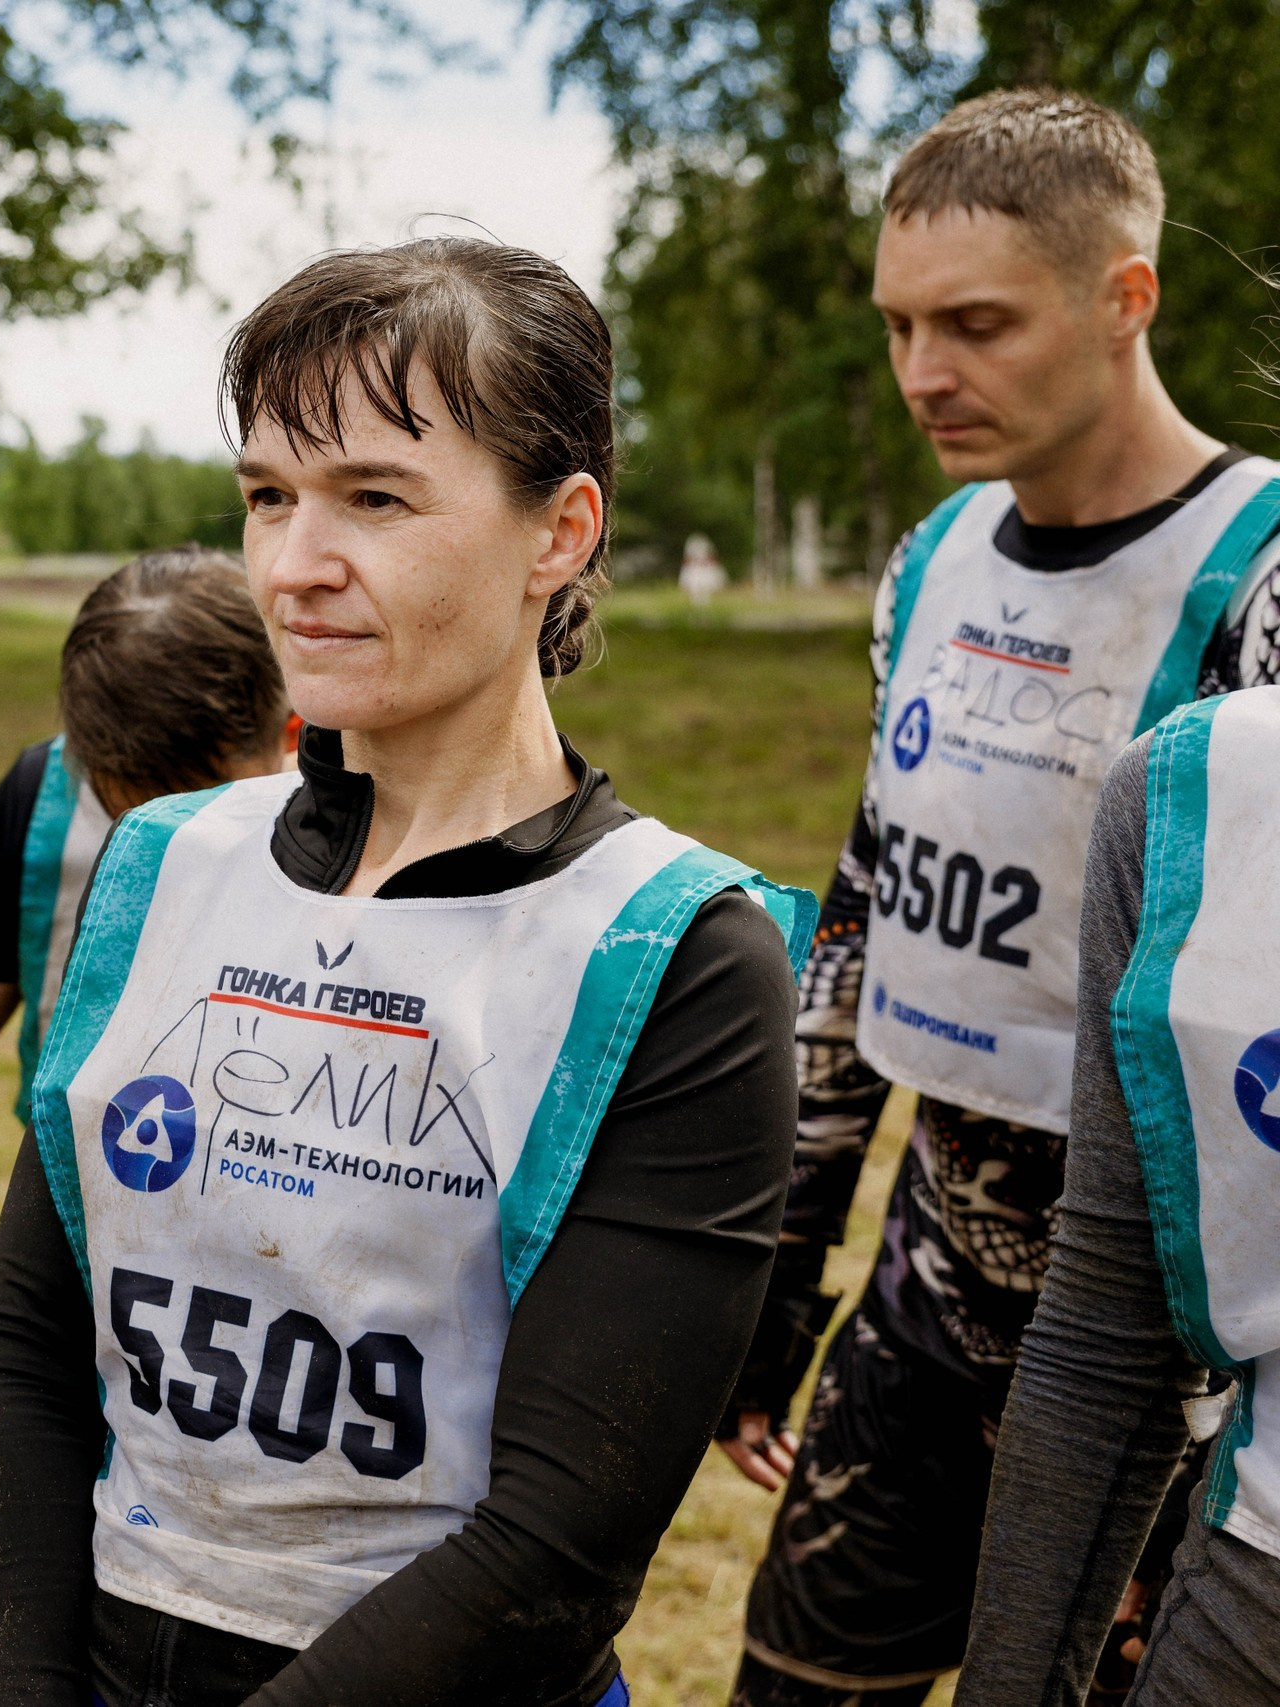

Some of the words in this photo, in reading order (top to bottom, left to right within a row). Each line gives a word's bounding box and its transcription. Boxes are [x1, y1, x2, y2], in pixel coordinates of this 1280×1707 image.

[877, 823, 1041, 969] 5502
[217, 965, 306, 1008] ГОНКА
[313, 982, 427, 1025] ГЕРОЕВ
[219, 1160, 315, 1198] РОСАТОМ
[224, 1128, 485, 1199] АЭМ-ТЕХНОЛОГИИ
[110, 1266, 427, 1480] 5509
